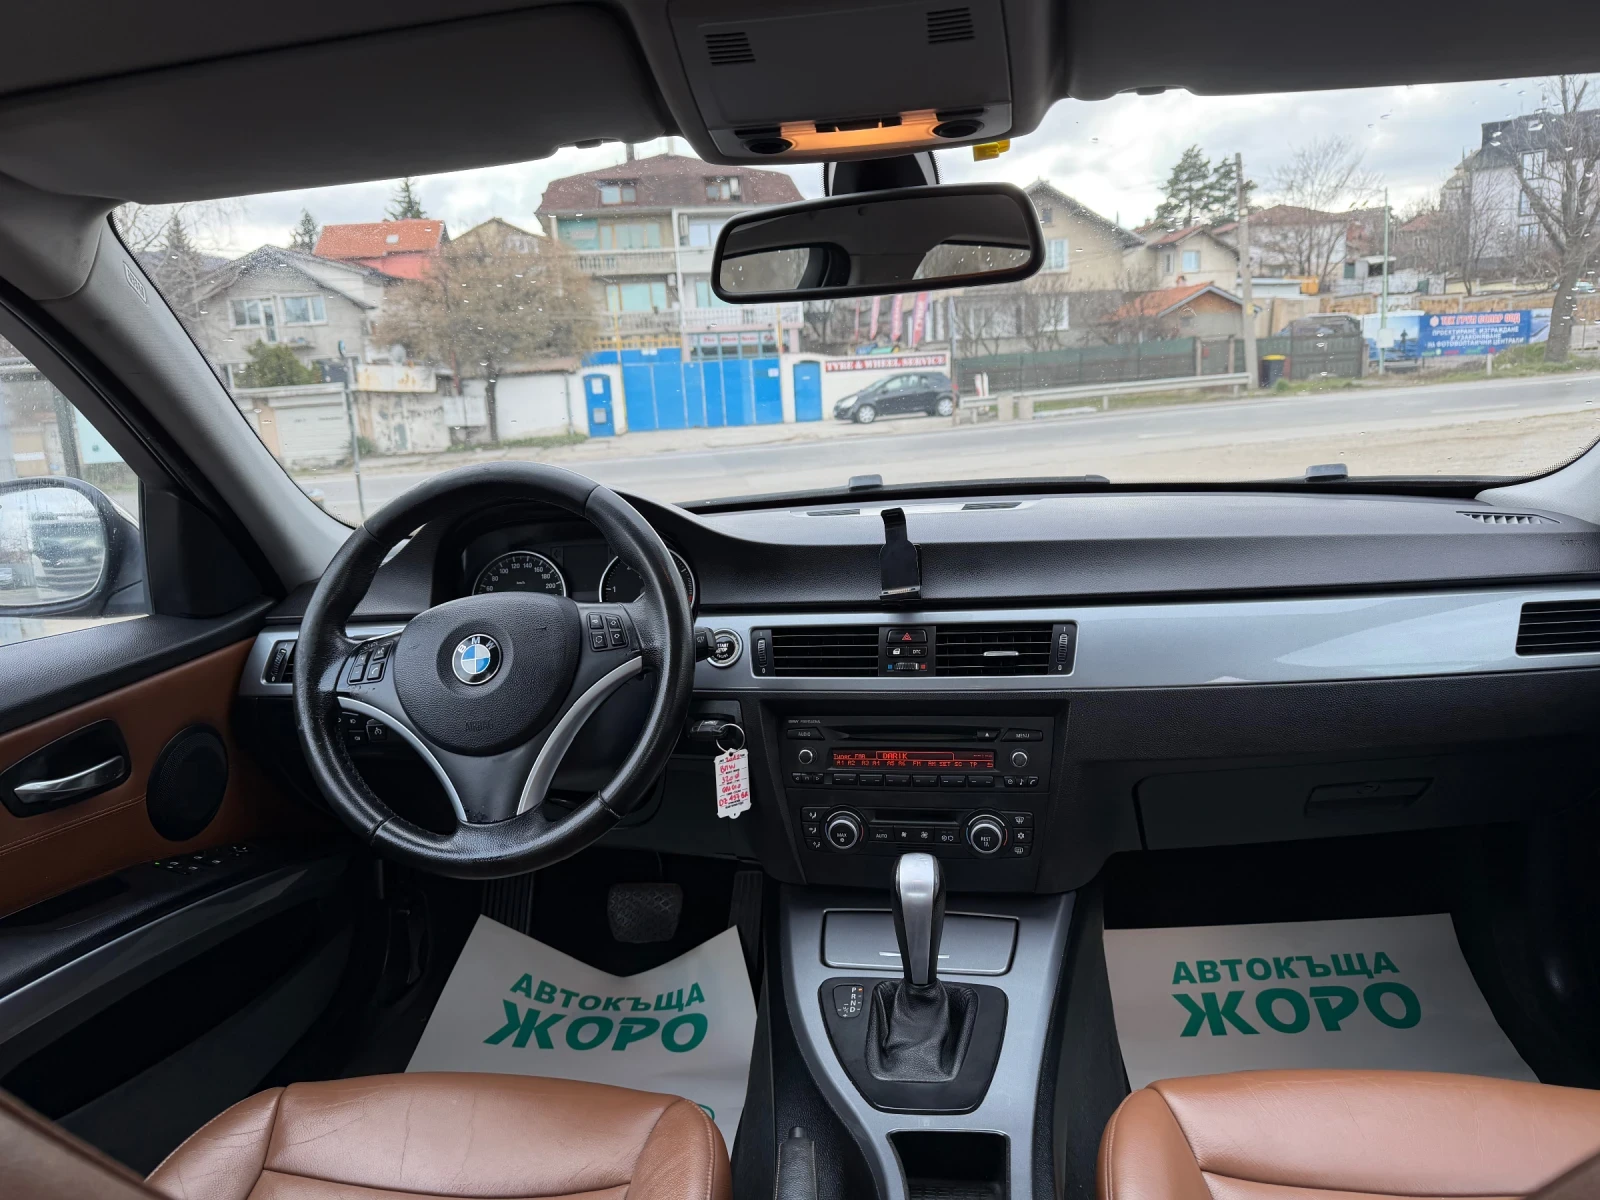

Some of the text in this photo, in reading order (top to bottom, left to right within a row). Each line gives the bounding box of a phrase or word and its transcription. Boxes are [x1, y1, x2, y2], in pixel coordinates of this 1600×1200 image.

[865, 358, 898, 370] WHEEL
[902, 355, 946, 368] SERVICE
[457, 636, 496, 653] BMW
[882, 752, 908, 760] DARIK
[1171, 951, 1400, 985] АВТОКЪЩА
[509, 972, 706, 1013] АВТОКЪЩА
[1171, 981, 1422, 1037] ЖОРО
[482, 998, 708, 1053] ЖОРО
